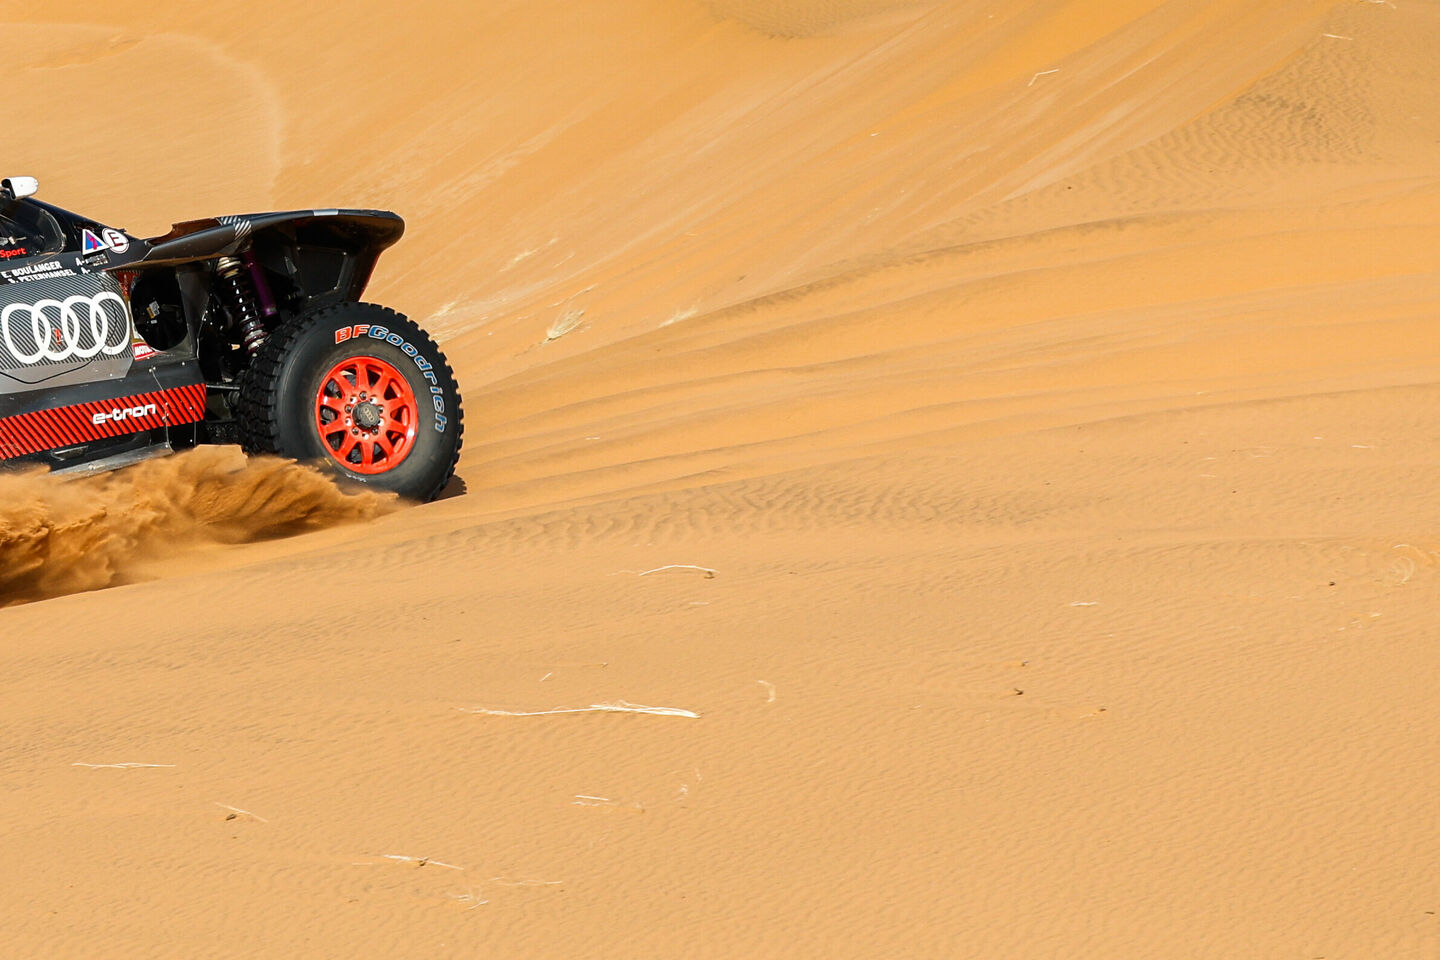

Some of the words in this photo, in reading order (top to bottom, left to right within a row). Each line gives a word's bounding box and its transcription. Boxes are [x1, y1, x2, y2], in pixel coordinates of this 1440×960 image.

[107, 232, 123, 247] E
[0, 247, 27, 258] Sport
[12, 260, 63, 277] BOULANGER
[18, 268, 77, 283] PETERHANSEL
[334, 324, 448, 433] BFGoodrich
[92, 403, 156, 425] e-tron
